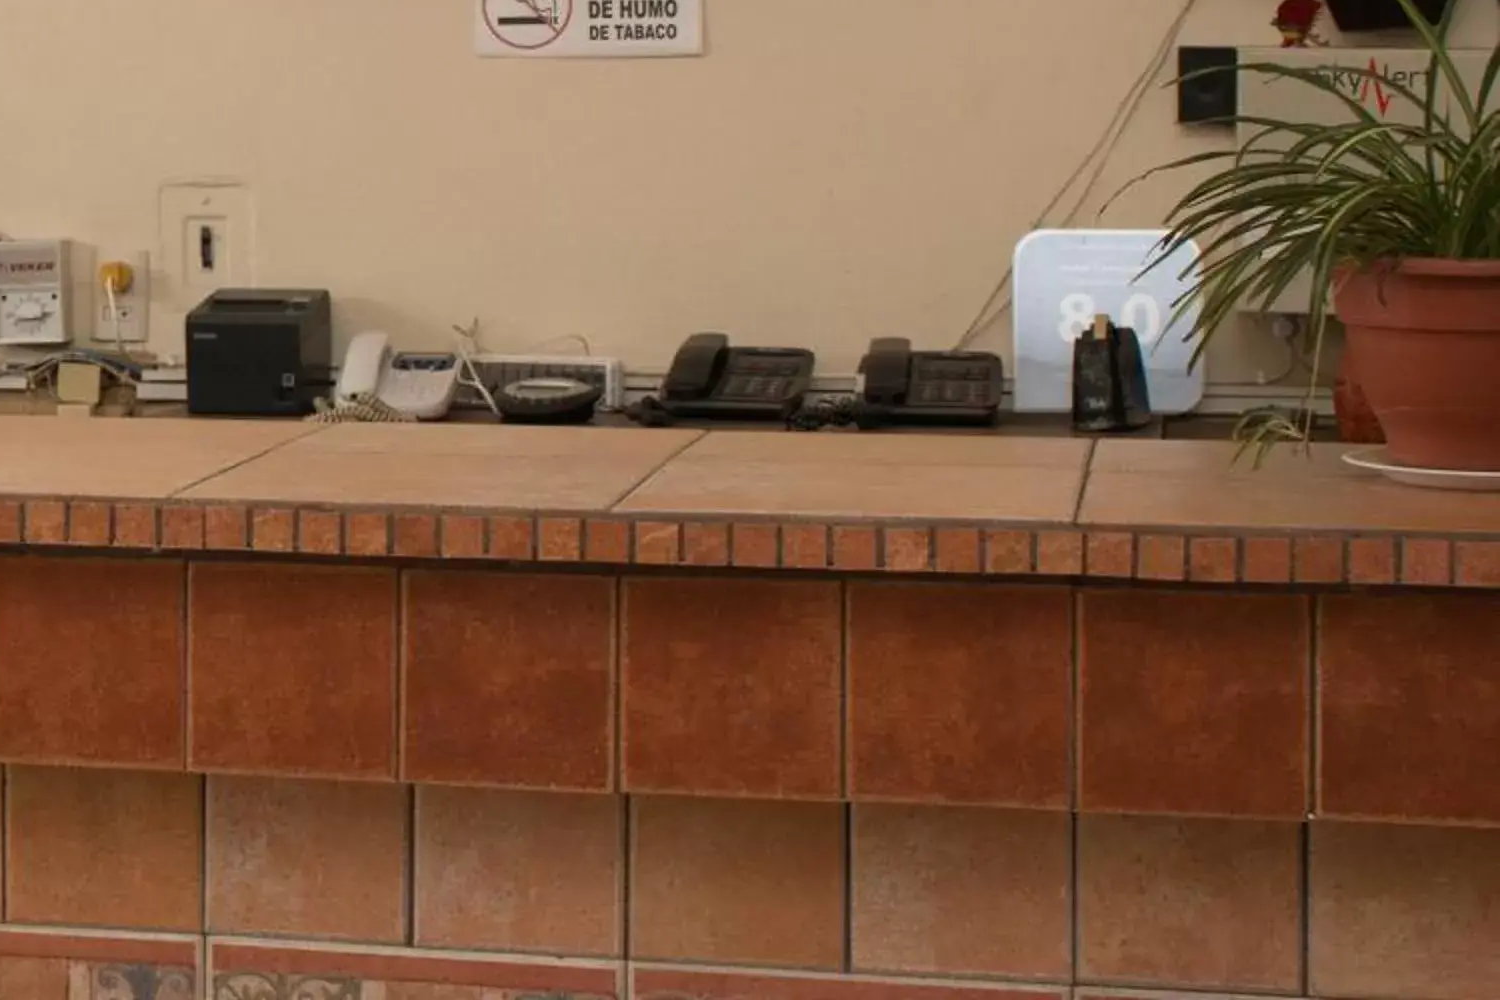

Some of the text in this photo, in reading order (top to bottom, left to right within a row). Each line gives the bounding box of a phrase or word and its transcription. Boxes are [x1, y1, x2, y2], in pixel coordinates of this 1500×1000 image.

[588, 0, 678, 19] DE HUMO
[589, 24, 677, 40] DE TABACO
